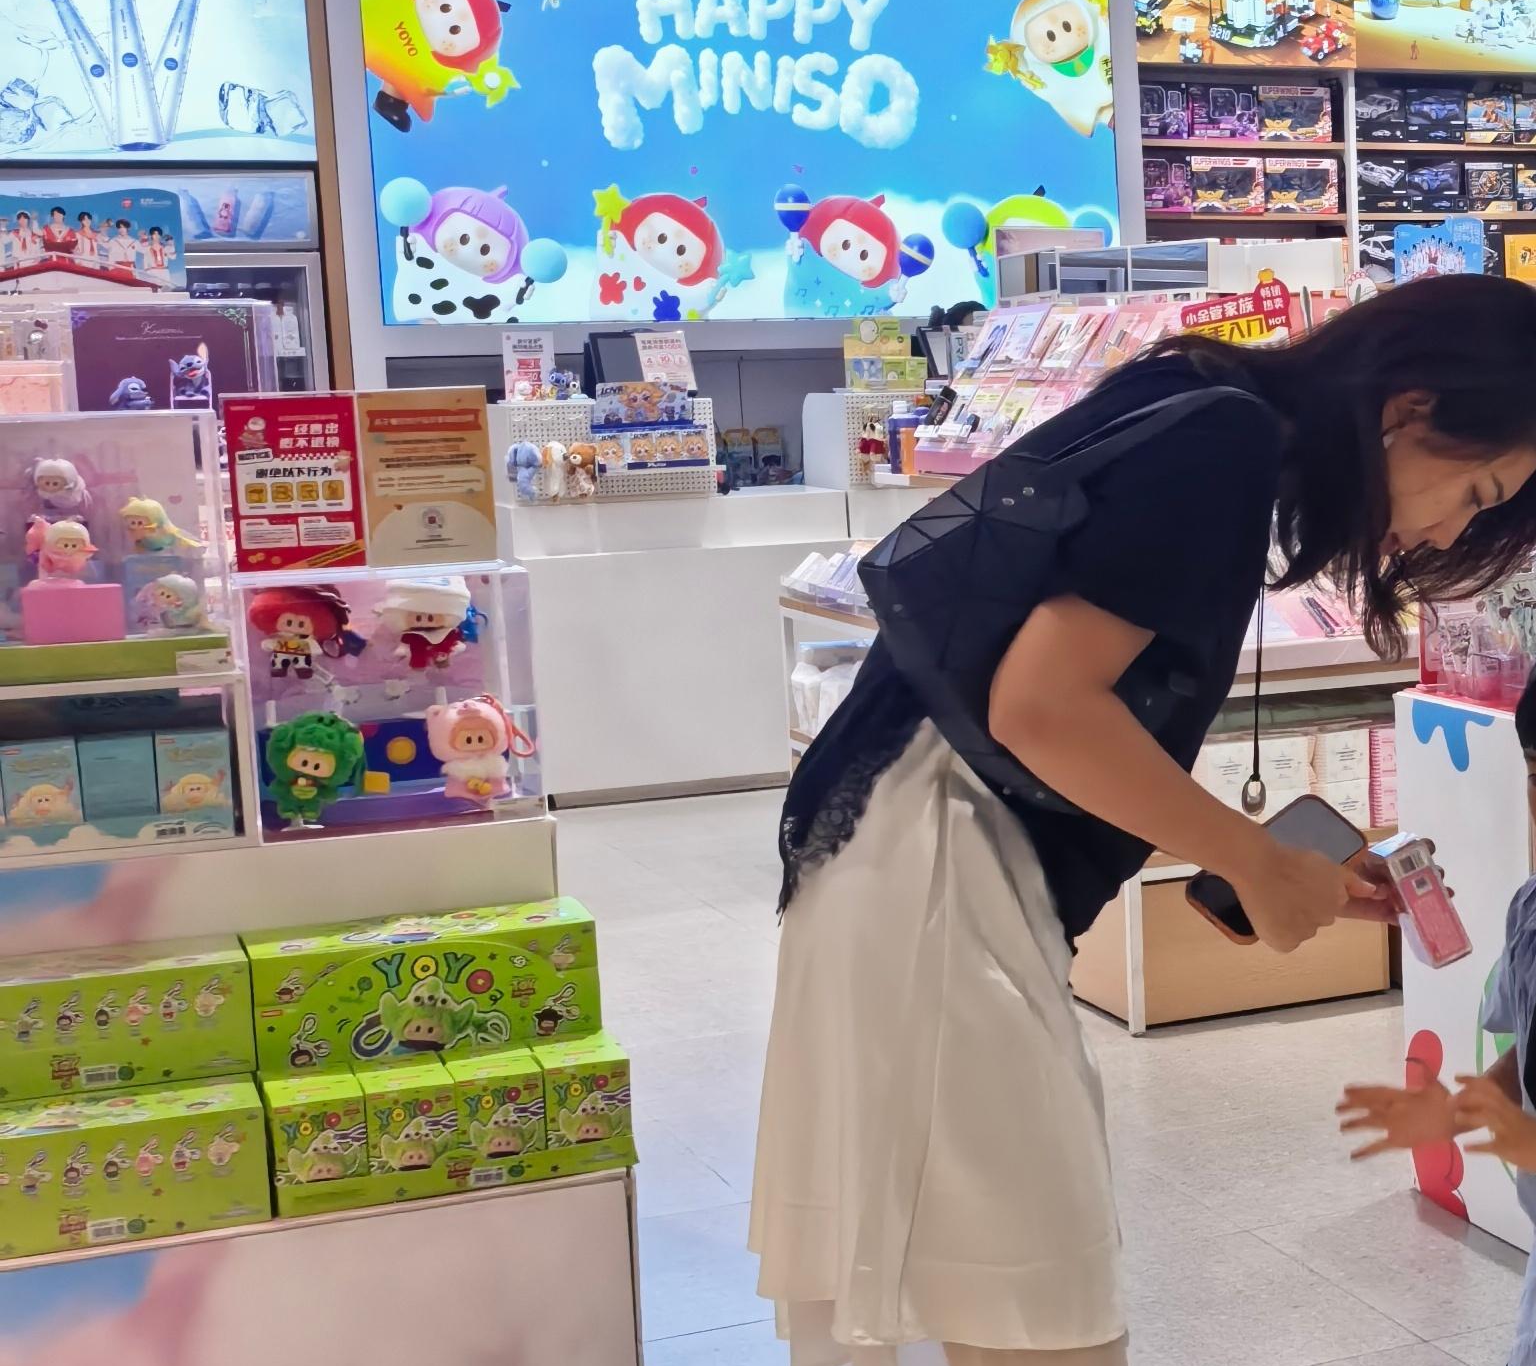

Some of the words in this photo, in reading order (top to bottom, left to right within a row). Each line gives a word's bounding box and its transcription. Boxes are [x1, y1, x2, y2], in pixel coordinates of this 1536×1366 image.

[394, 21, 418, 57] YOYO
[593, 43, 920, 149] MINISO
[1260, 285, 1281, 298] 畅销
[1263, 297, 1284, 311] 热卖
[1186, 296, 1255, 326] 小金管家族
[1268, 315, 1287, 326] HOT
[1197, 316, 1264, 343] 手入门
[373, 951, 494, 994] YOYO
[464, 1085, 522, 1117] YOYO
[554, 1074, 609, 1105] YOYO
[280, 1111, 342, 1143] YOYO
[374, 1098, 433, 1130] YOYO
